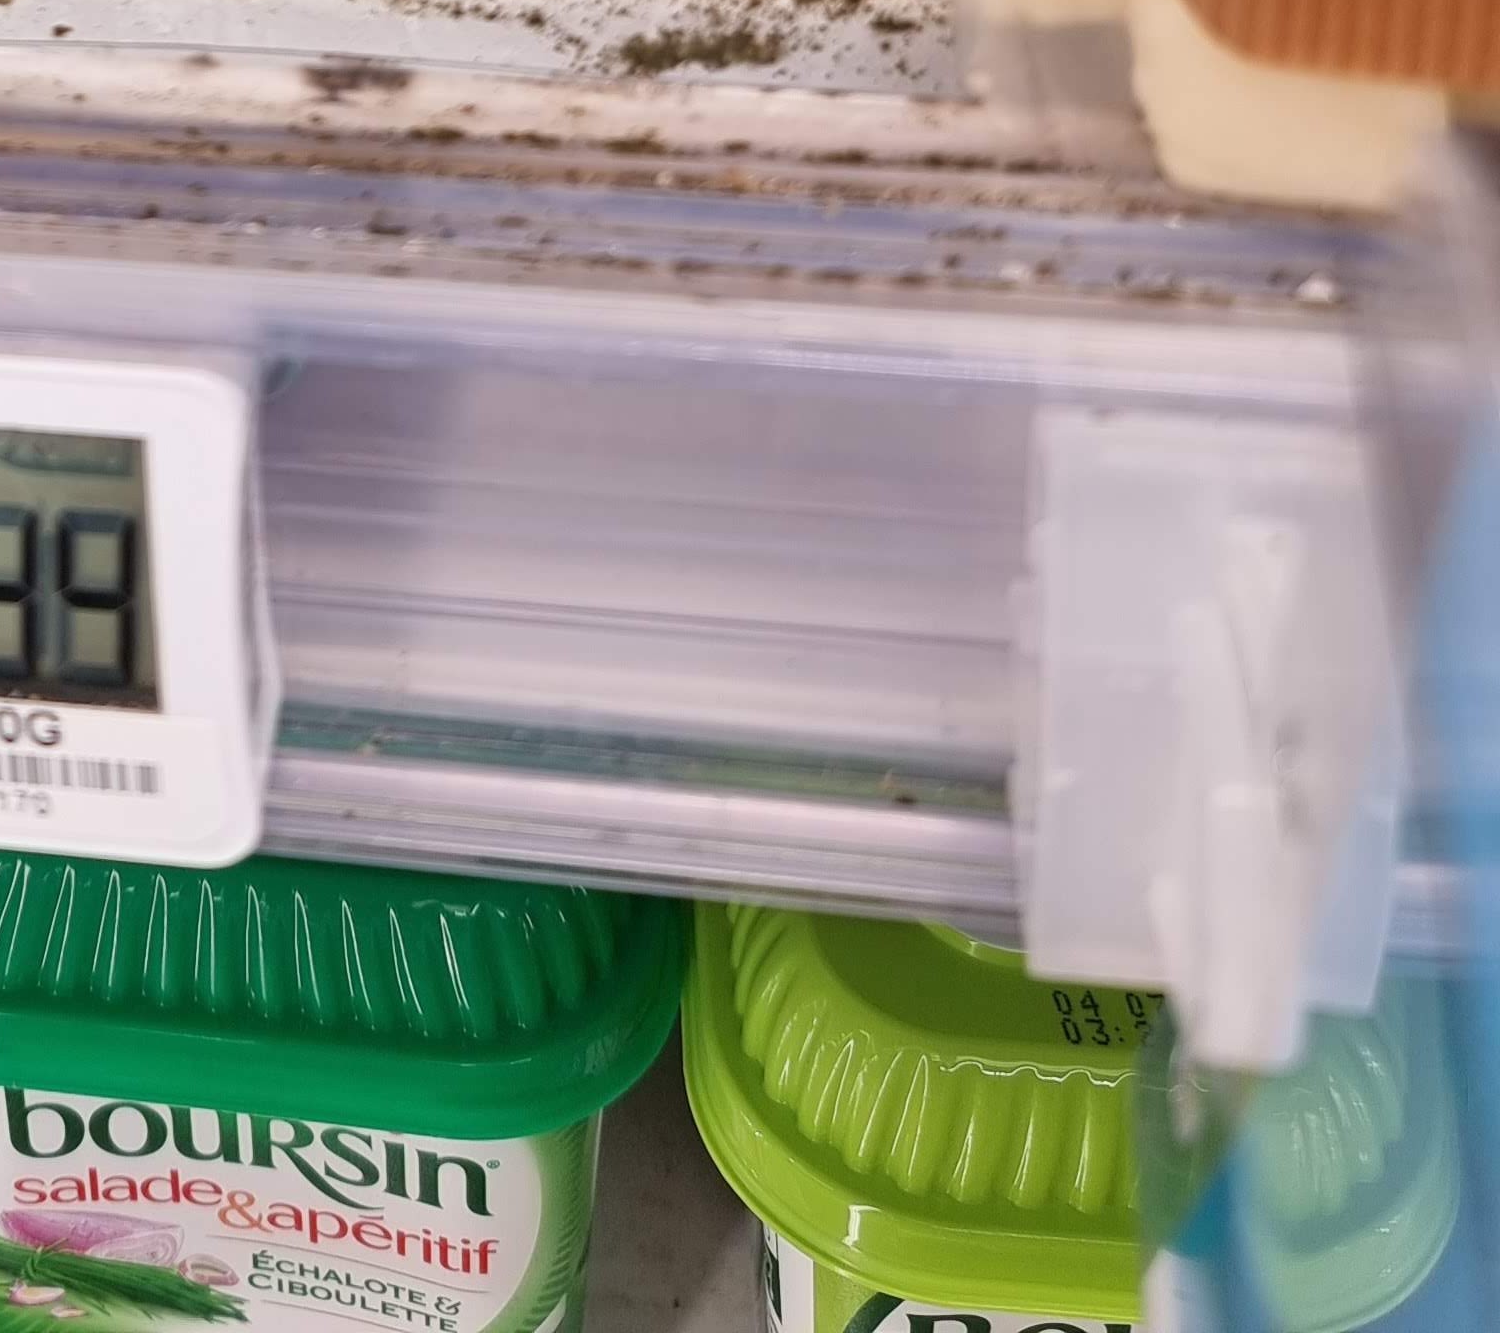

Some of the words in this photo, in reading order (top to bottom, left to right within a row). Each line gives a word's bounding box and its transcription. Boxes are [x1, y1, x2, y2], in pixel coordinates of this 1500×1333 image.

[1052, 989, 1099, 1017] 04
[247, 1272, 459, 1333] CIBOULETTE
[252, 1249, 428, 1307] ÉCHALOTE
[434, 1296, 462, 1317] &
